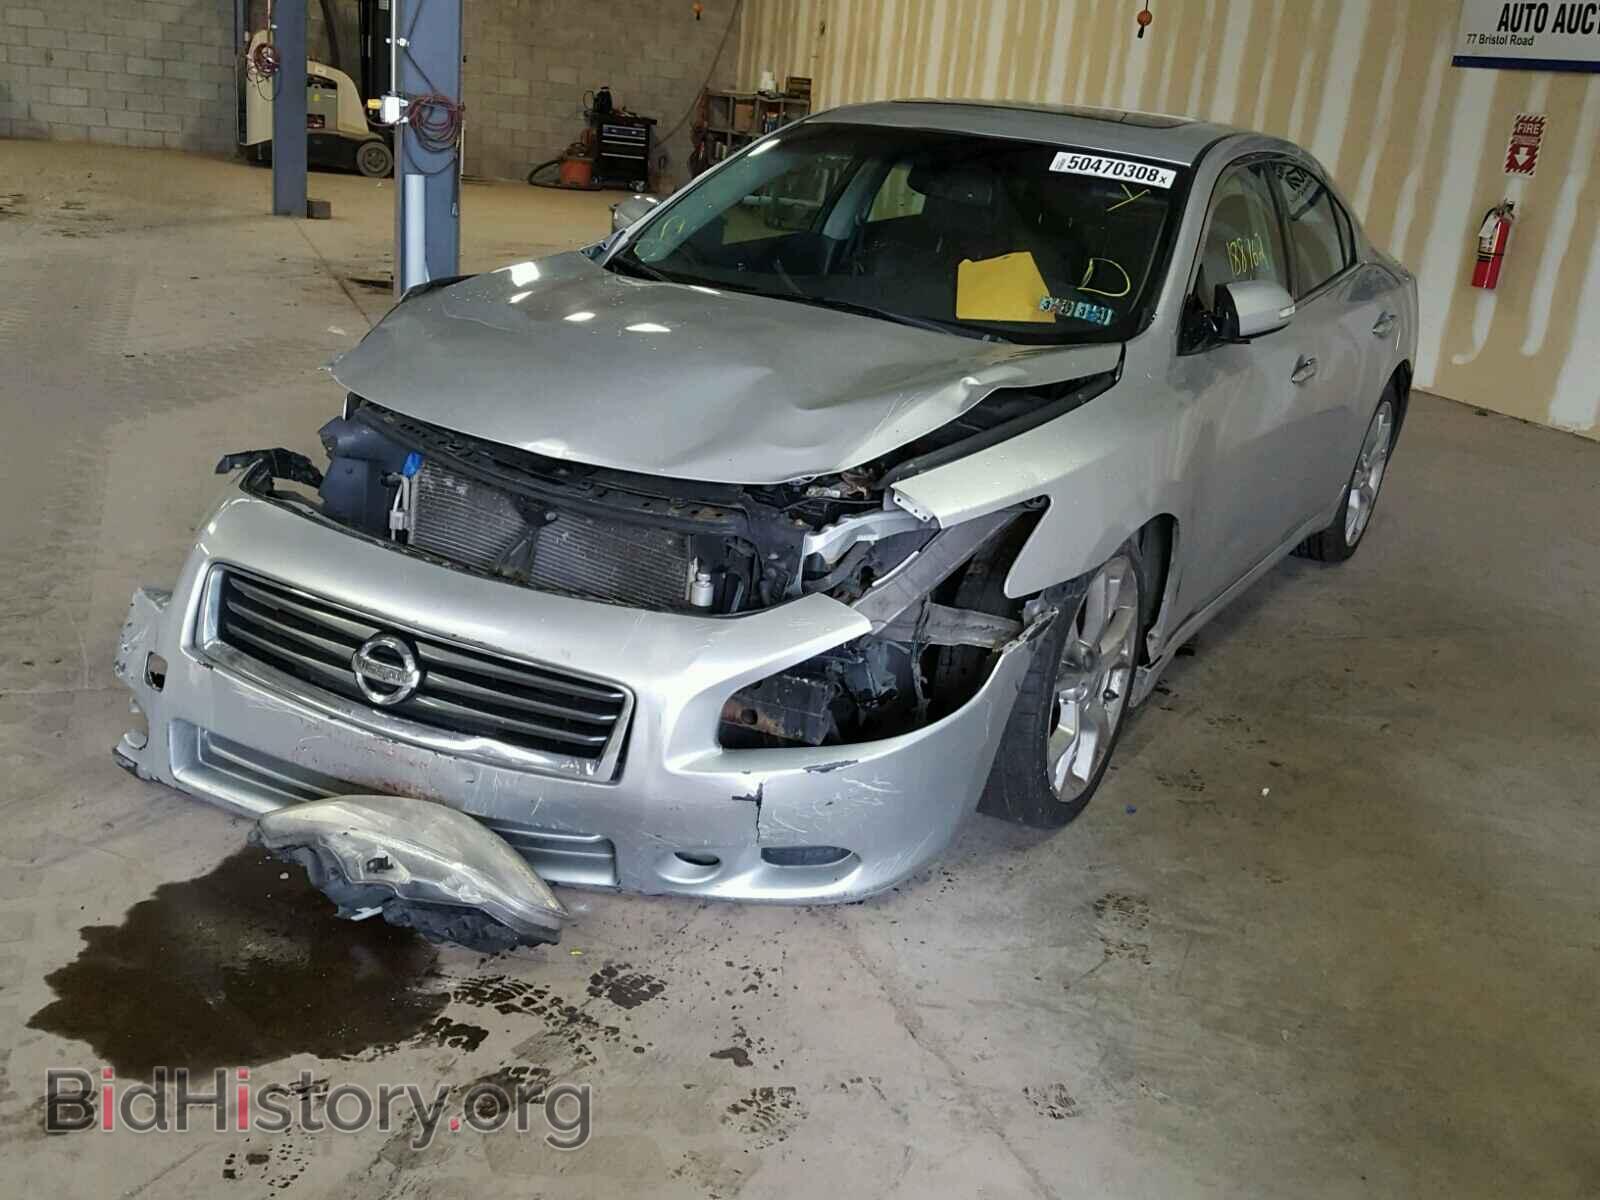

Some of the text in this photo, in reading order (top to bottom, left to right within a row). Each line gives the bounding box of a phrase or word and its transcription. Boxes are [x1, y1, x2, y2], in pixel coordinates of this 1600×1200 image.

[1496, 2, 1600, 35] AUTO AUC
[1466, 33, 1535, 46] 77 Bristol Road
[1516, 121, 1541, 135] FIRE
